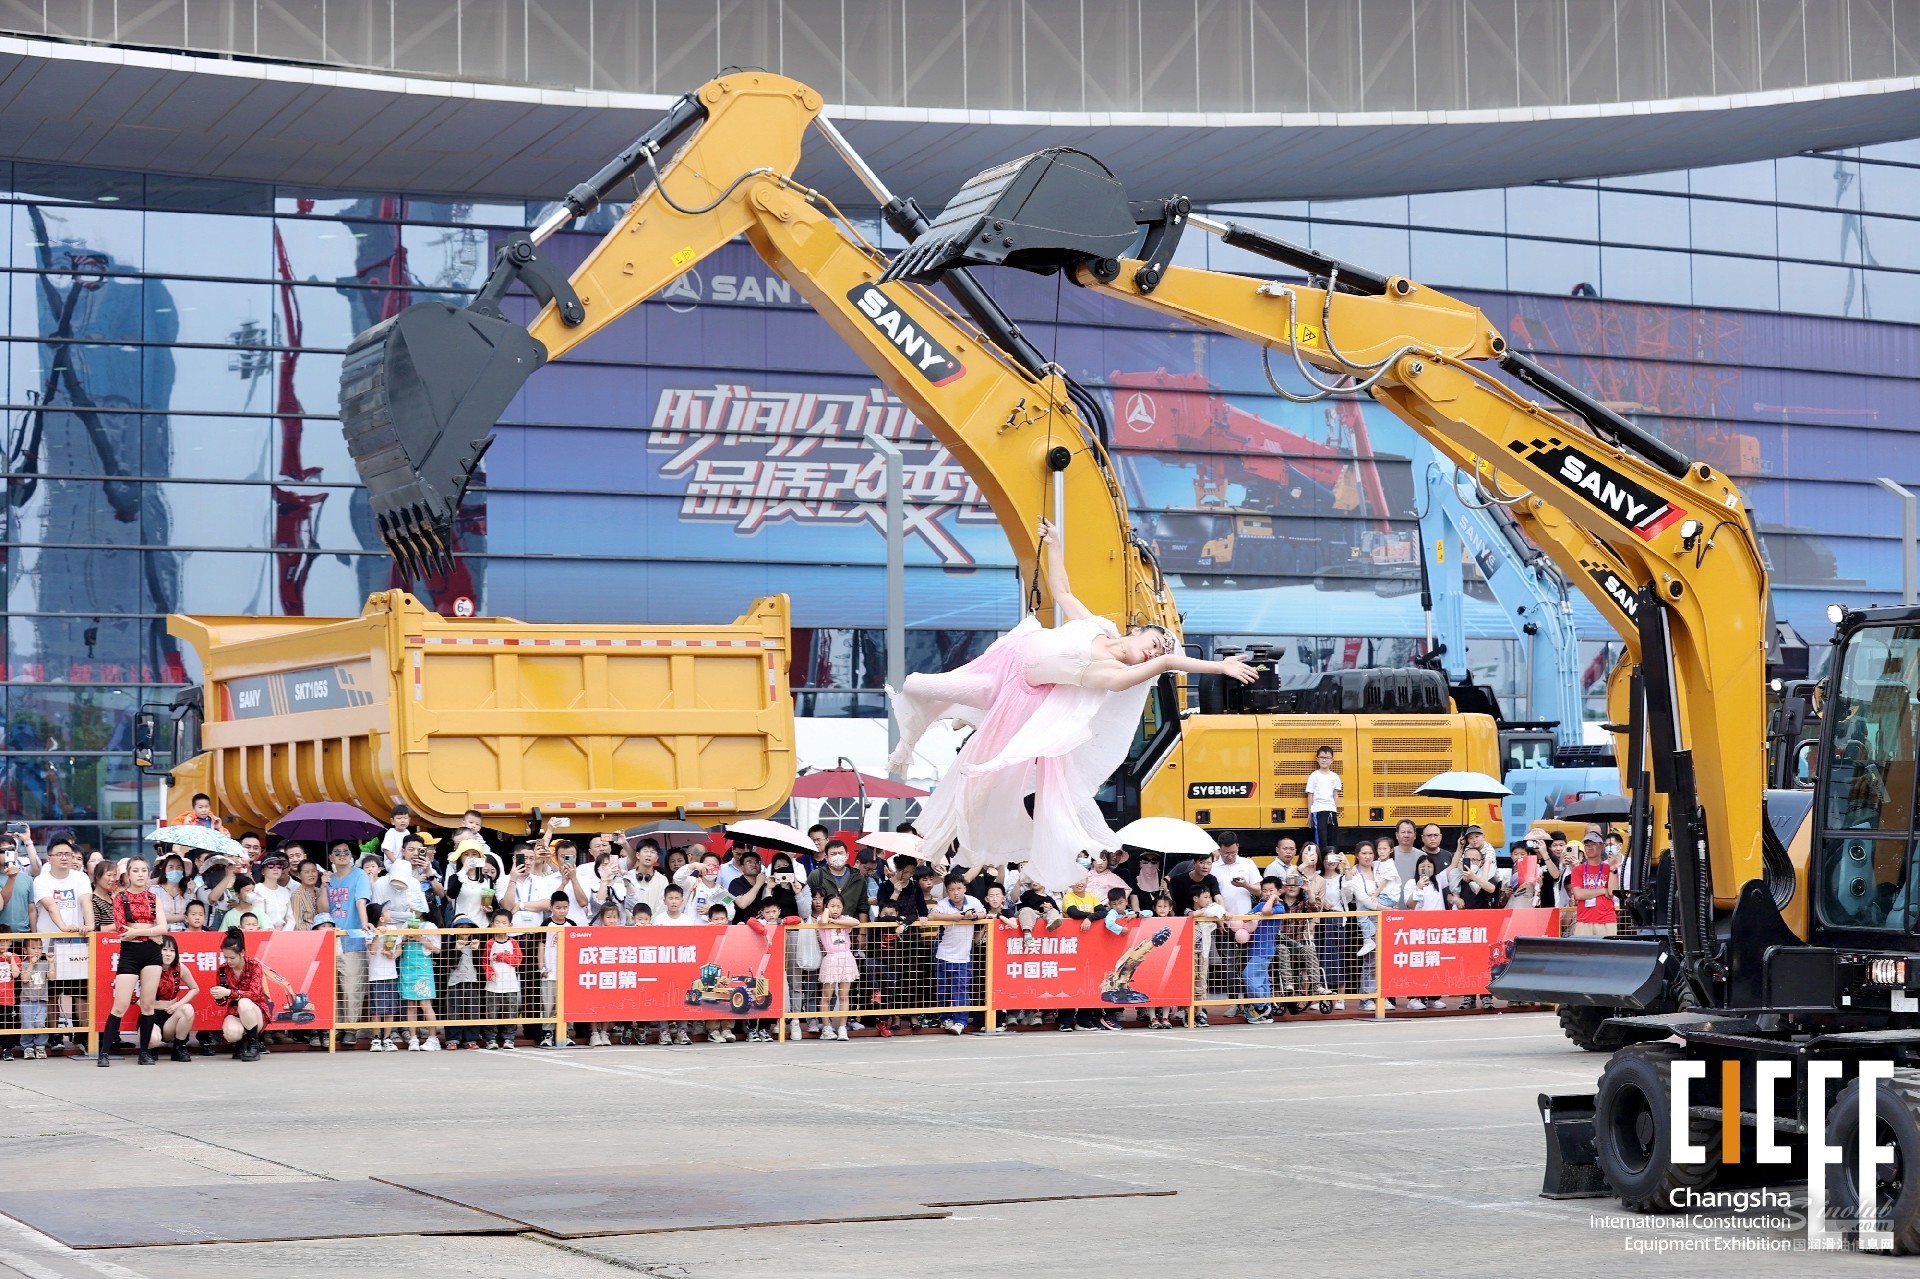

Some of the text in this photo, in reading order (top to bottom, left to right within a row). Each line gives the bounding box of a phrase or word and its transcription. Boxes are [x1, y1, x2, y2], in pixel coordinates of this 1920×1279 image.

[711, 275, 810, 304] SAN
[857, 289, 946, 370] SANY
[1560, 455, 1648, 521] SANY
[1459, 514, 1490, 559] SANY
[1604, 575, 1639, 622] SAN
[239, 680, 328, 709] SANY SKT105S
[1192, 785, 1247, 796] SY650H-S
[1393, 927, 1488, 946] 大吨位起重机
[578, 945, 696, 965] 成套路面机械
[1393, 951, 1456, 968] 中国第一
[578, 971, 657, 990] 中国第一
[1006, 961, 1076, 979] 中国第一
